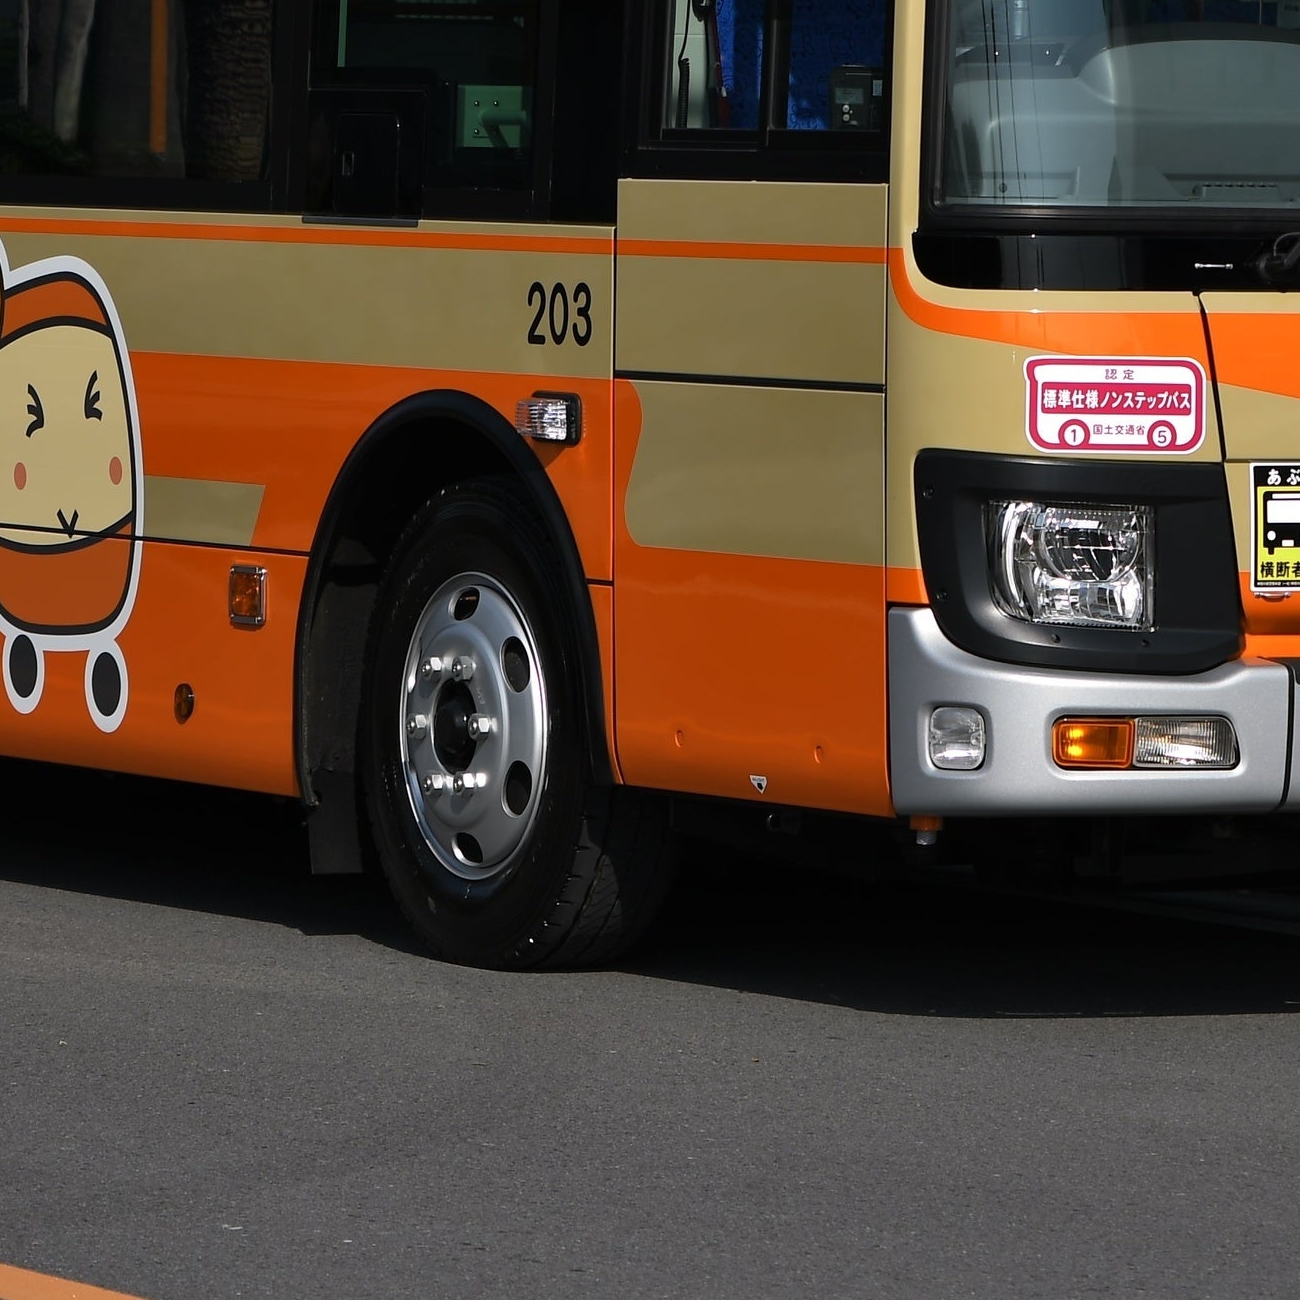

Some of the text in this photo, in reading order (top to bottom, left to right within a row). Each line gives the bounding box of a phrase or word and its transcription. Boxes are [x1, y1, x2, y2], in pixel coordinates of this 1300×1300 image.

[527, 281, 592, 347] 203
[1105, 369, 1135, 381] 認定
[1043, 389, 1191, 410] 標準仕様ノンステップバス
[1070, 428, 1078, 443] 1
[1093, 423, 1147, 436] 国土交通省
[1157, 430, 1168, 444] 5
